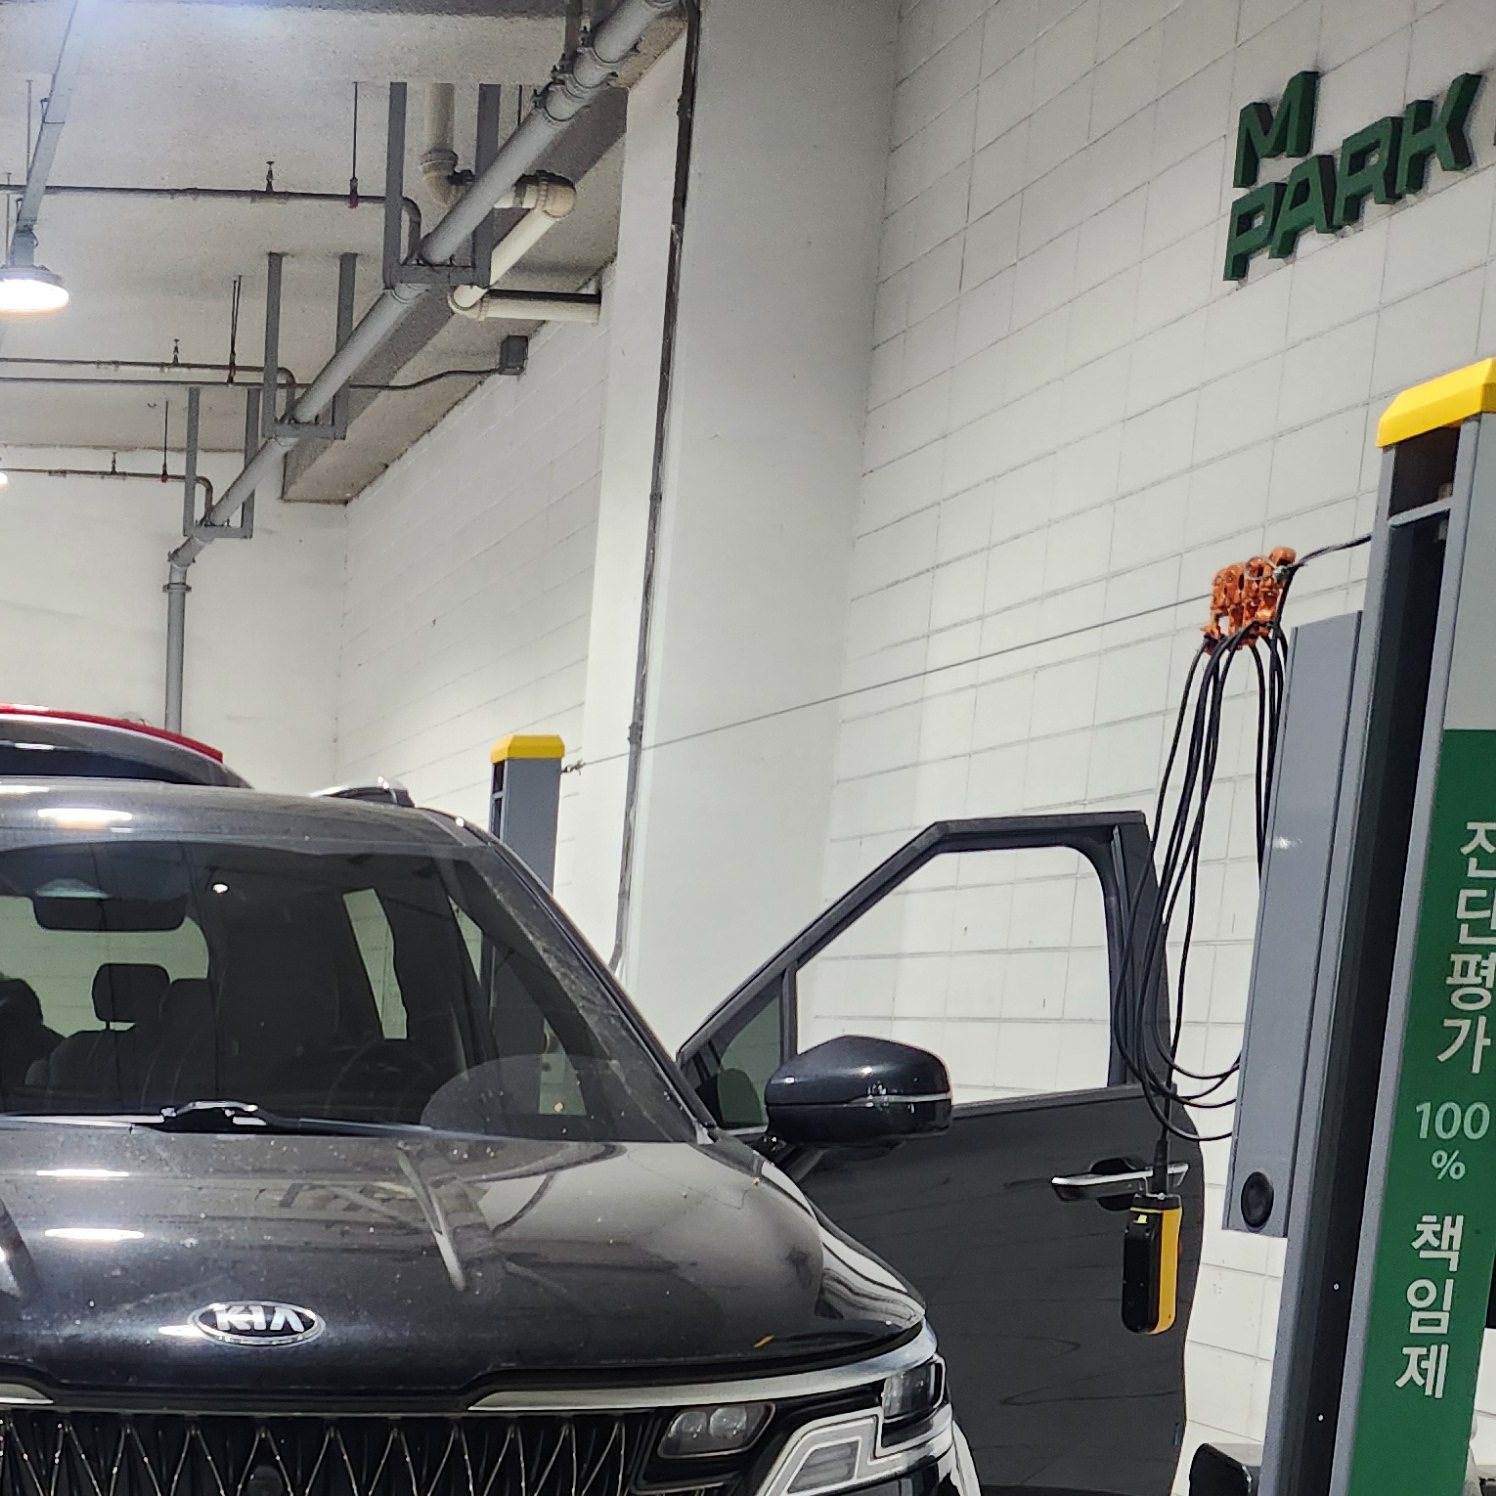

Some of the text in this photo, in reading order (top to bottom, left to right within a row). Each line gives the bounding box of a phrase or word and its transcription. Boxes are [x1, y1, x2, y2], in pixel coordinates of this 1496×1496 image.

[1233, 70, 1320, 188] M
[1223, 72, 1483, 281] PARK
[1415, 1100, 1491, 1140] 100
[1431, 1150, 1467, 1180] %
[215, 1304, 305, 1333] KIA
[1395, 1214, 1465, 1399] 책임제
